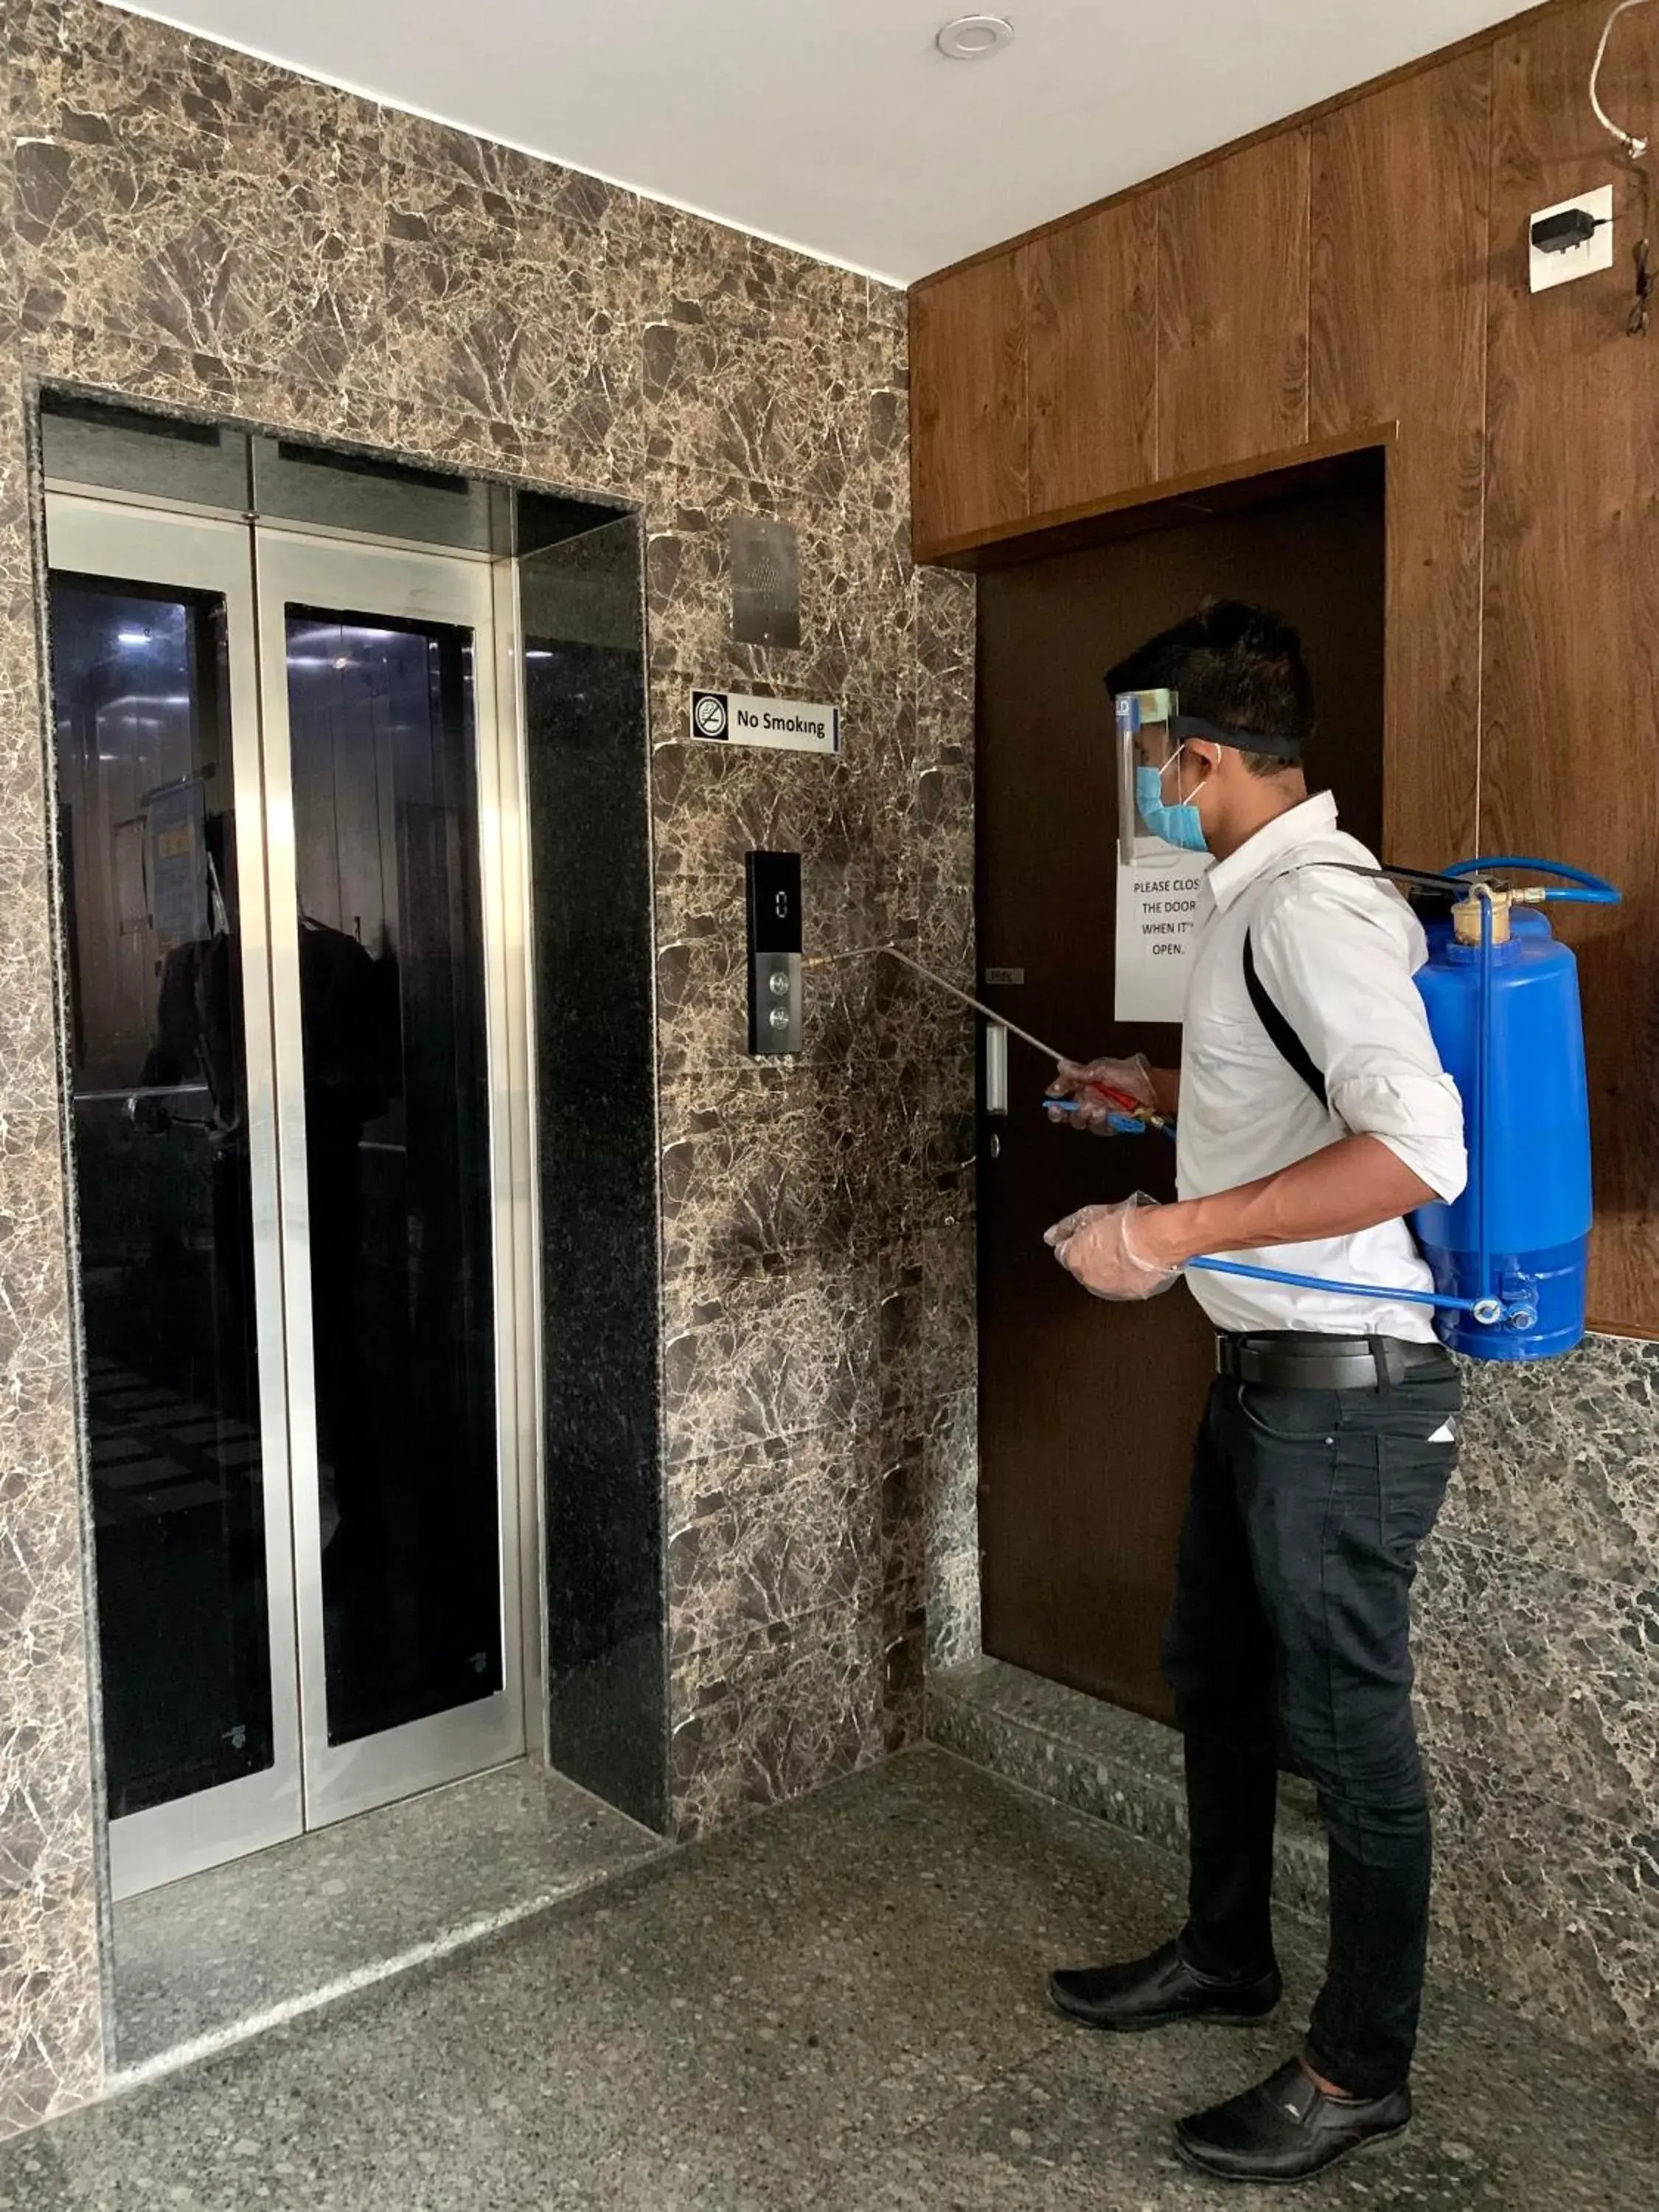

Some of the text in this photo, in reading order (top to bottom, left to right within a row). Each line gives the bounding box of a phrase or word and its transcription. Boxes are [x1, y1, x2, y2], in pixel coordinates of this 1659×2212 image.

[737, 709, 825, 739] No Smoking
[1133, 878, 1200, 893] PLEASE CLOS
[1142, 902, 1162, 914] THE
[1142, 922, 1175, 934] WHEN
[1152, 944, 1185, 955] OPEN.
